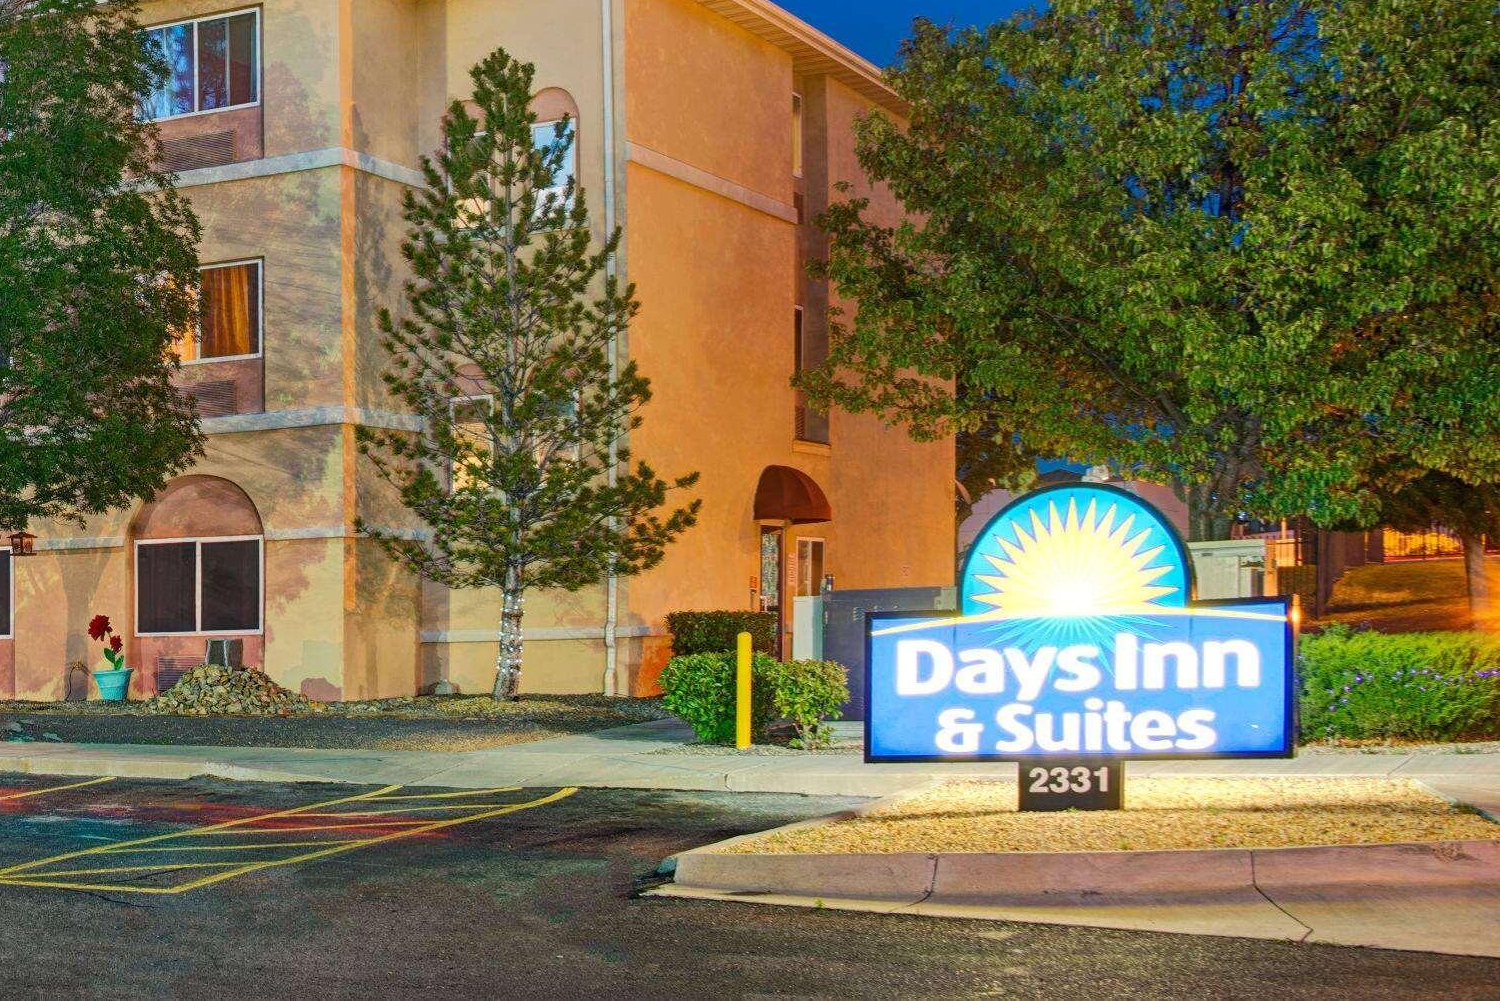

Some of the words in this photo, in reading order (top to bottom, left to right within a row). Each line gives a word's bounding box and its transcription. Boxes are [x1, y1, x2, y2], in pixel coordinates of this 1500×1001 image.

[896, 639, 1098, 700] Days
[1115, 632, 1261, 691] Inn
[935, 707, 984, 753] &
[996, 698, 1218, 753] Suites
[1028, 766, 1109, 794] 2331
